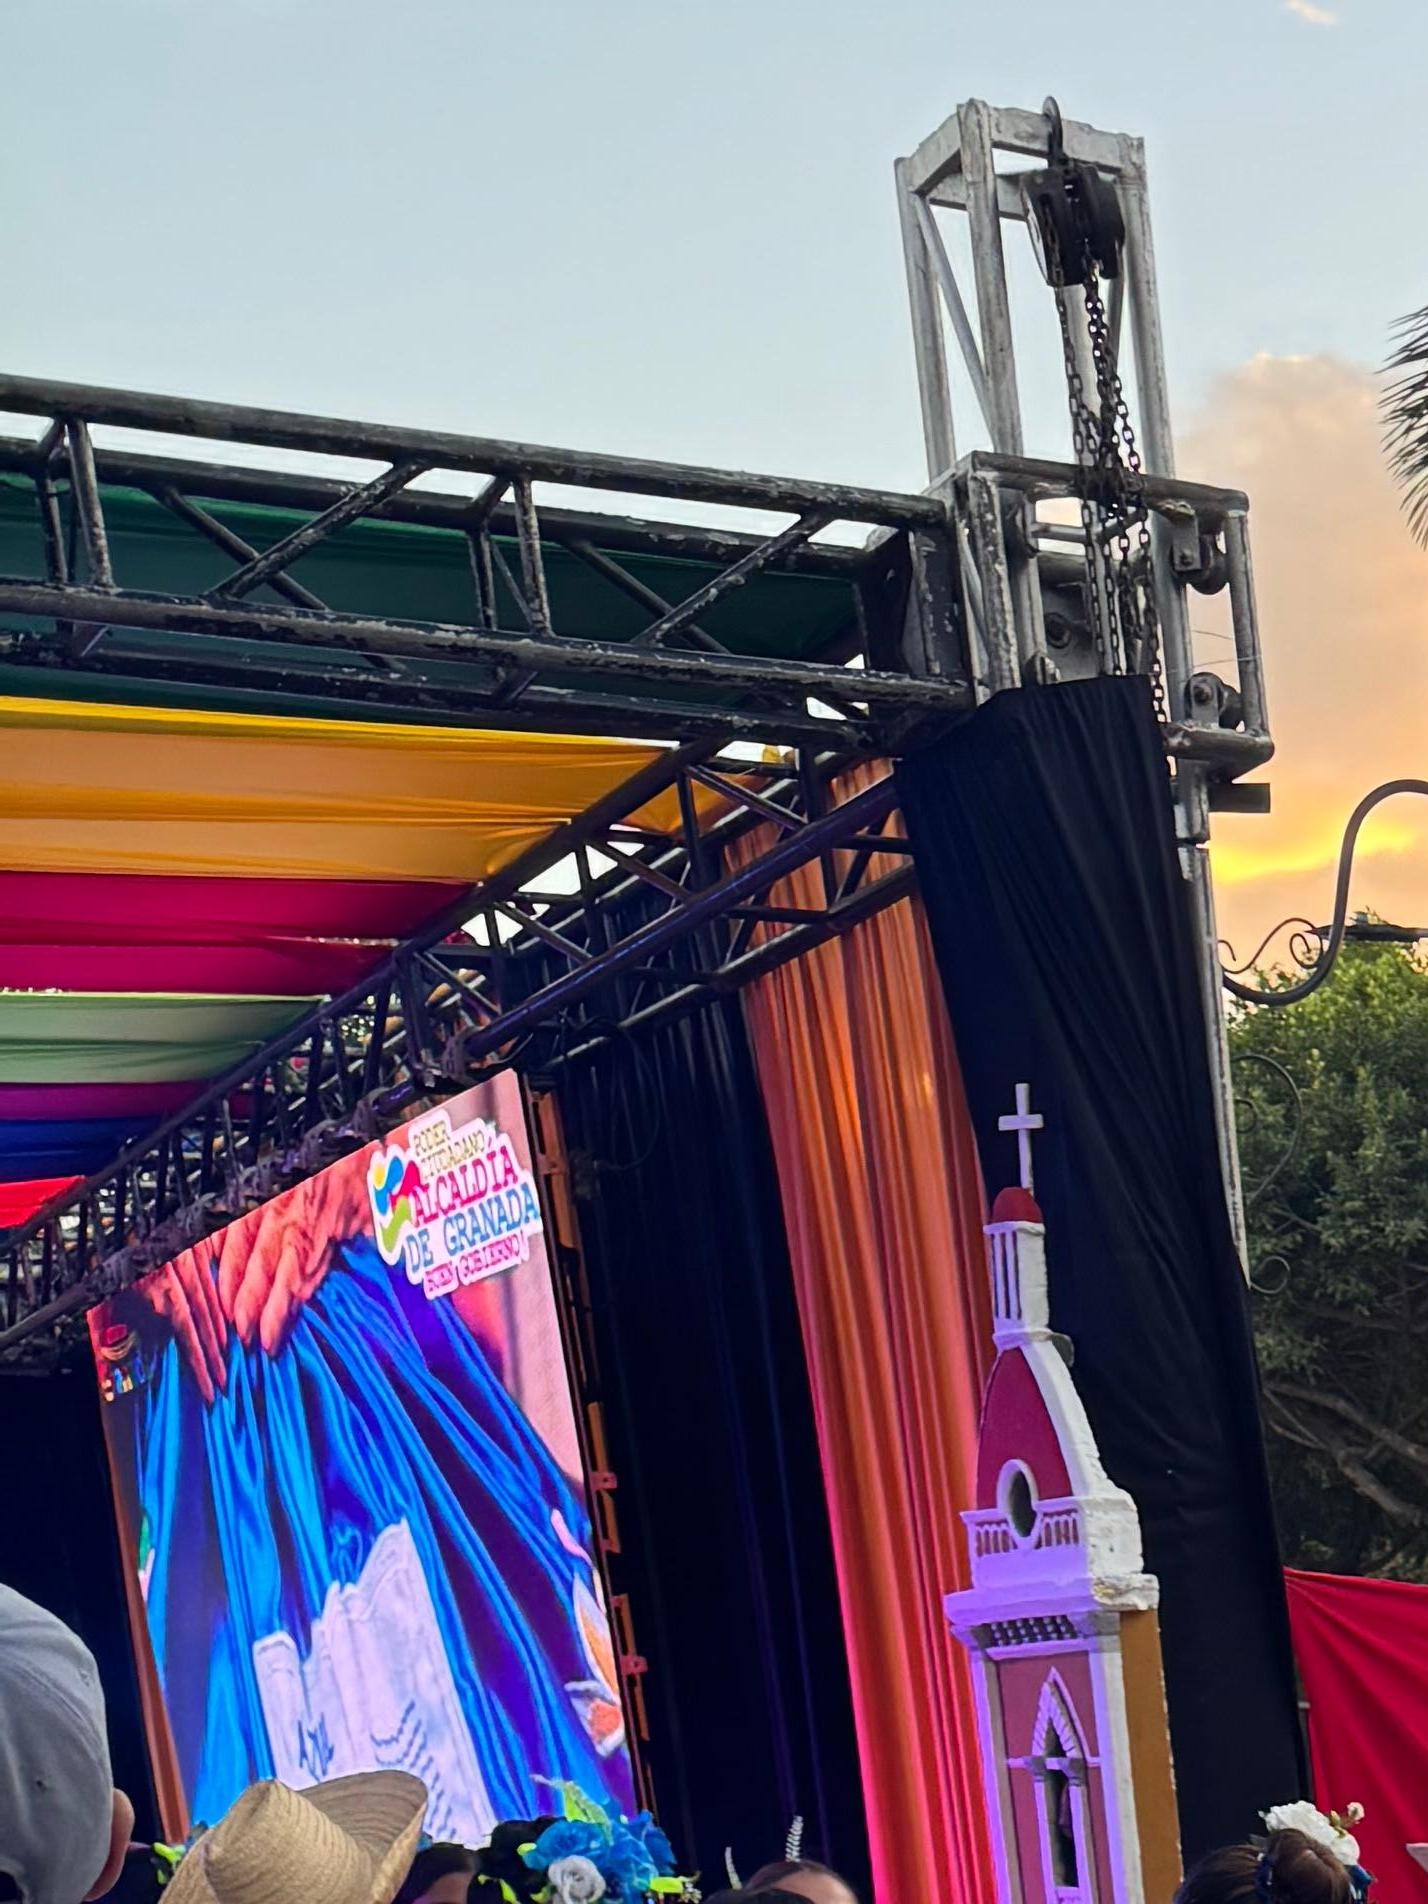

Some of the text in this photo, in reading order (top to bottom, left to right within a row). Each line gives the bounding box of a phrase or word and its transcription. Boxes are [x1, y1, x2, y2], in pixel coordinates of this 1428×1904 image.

[410, 1136, 519, 1226] ALCALDÍA
[406, 1181, 542, 1272] DE GRANADA
